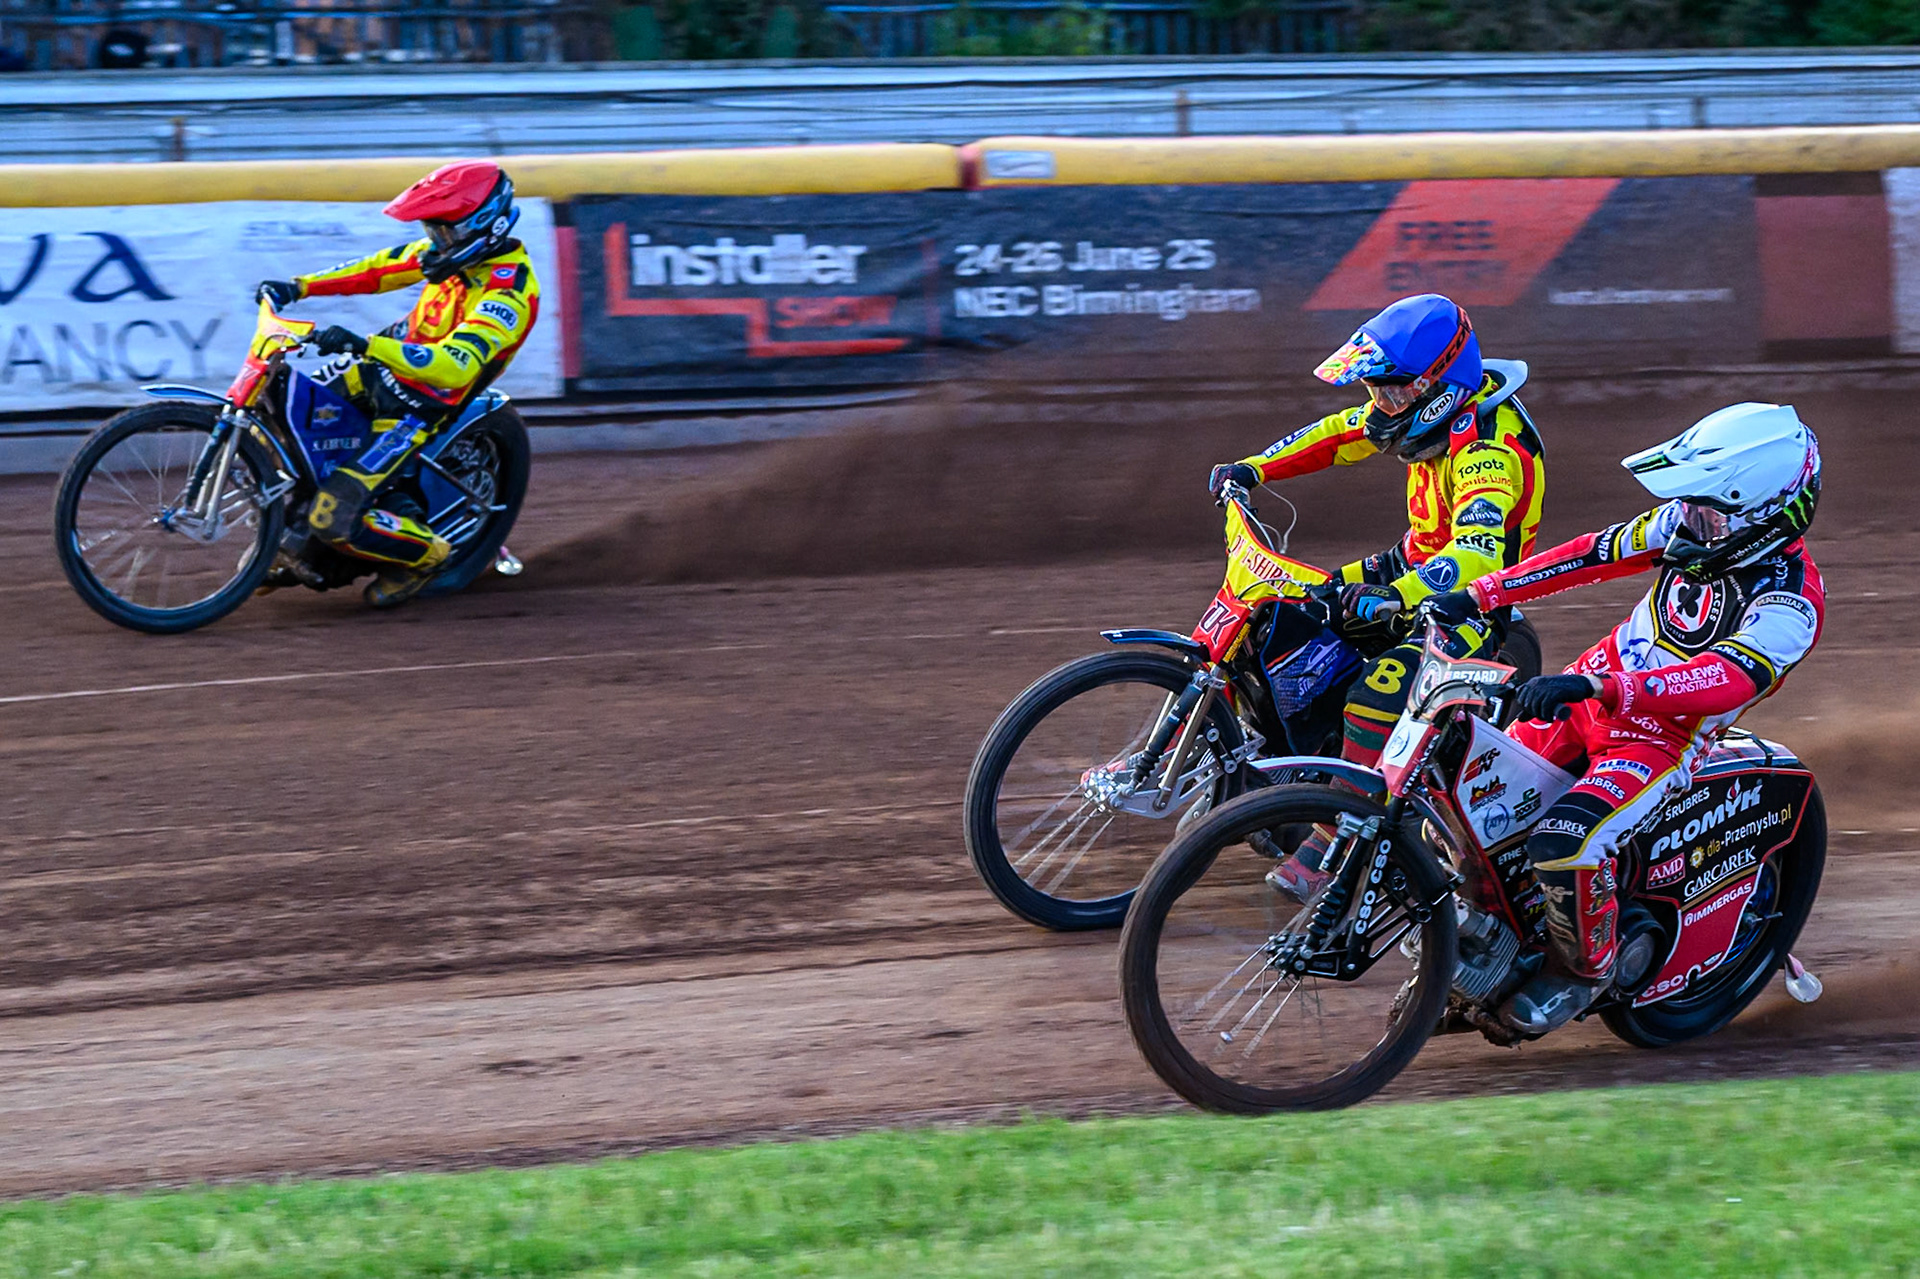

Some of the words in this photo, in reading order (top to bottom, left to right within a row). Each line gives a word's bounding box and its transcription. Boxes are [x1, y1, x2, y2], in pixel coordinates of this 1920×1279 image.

[1065, 241, 1163, 271] June
[1164, 238, 1218, 270] 25
[953, 285, 1039, 318] NEC
[1042, 282, 1262, 322] Birmingham
[1365, 658, 1407, 694] B
[1355, 889, 1377, 935] CSO
[1370, 838, 1392, 885] CSO
[1650, 857, 1684, 882] AMD
